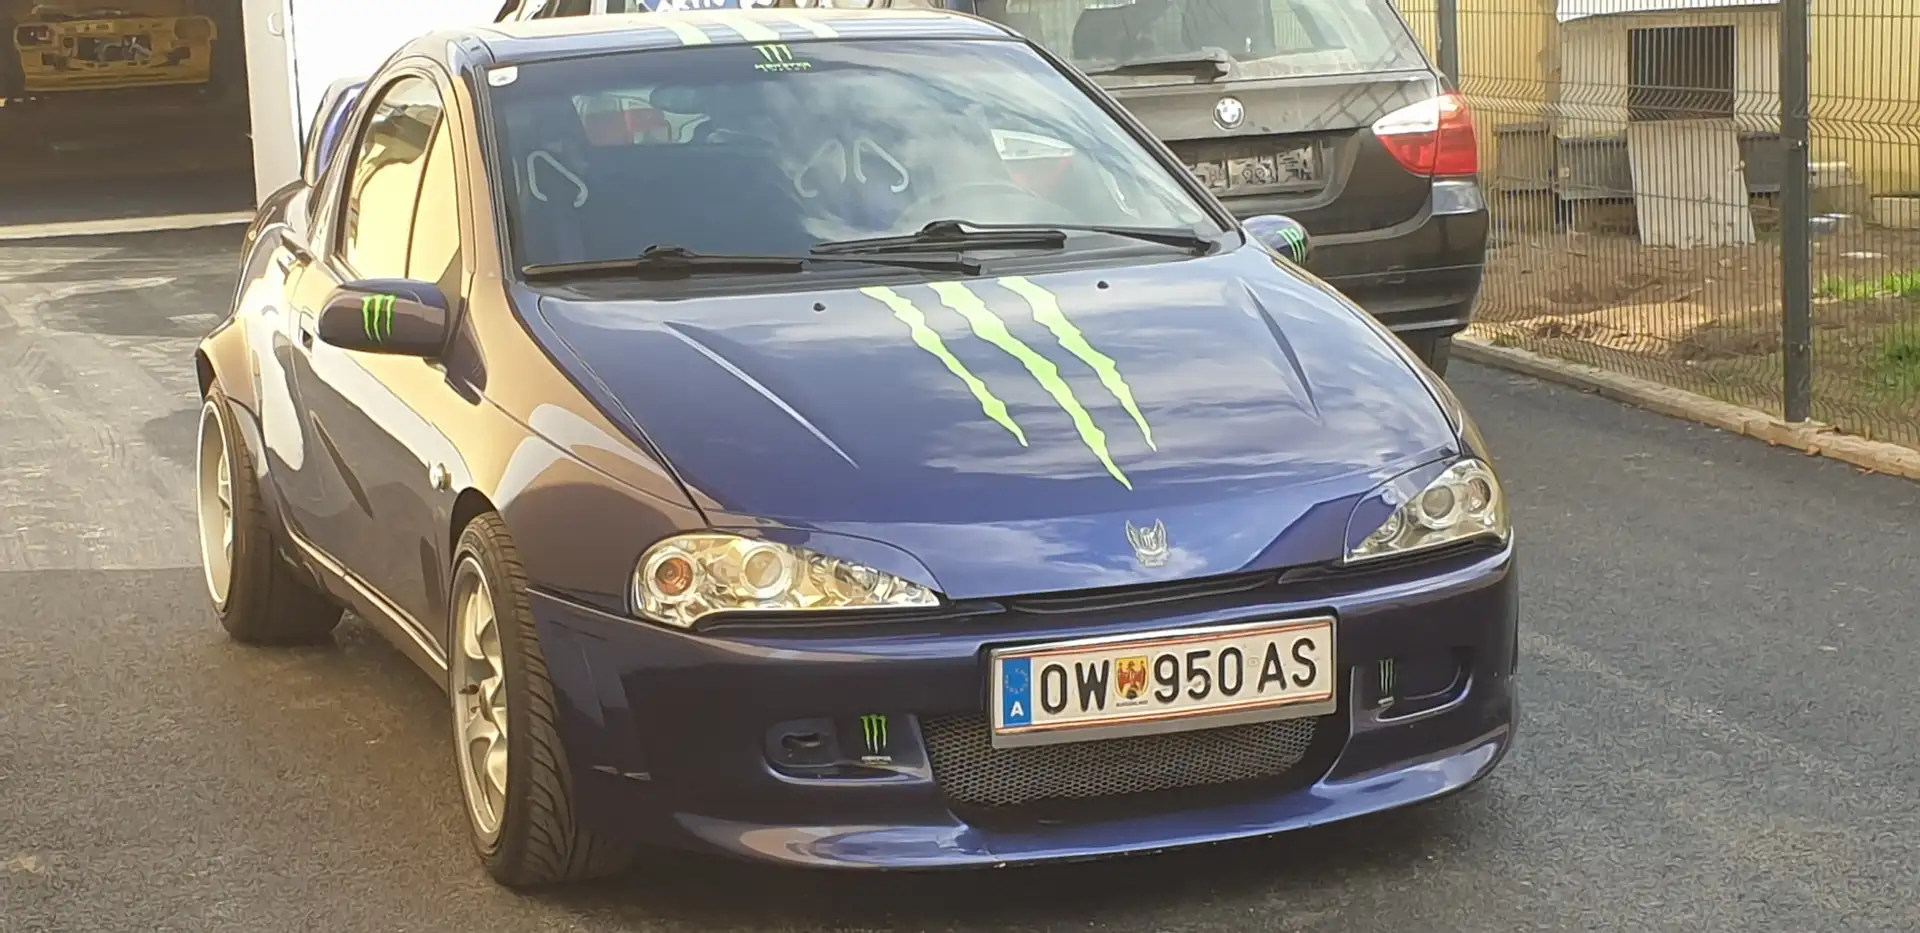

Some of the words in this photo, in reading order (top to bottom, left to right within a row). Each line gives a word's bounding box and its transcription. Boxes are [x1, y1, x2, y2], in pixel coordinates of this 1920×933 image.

[1041, 660, 1110, 714] OW
[1154, 647, 1243, 703] 950
[1257, 637, 1316, 693] AS
[1010, 700, 1024, 717] A
